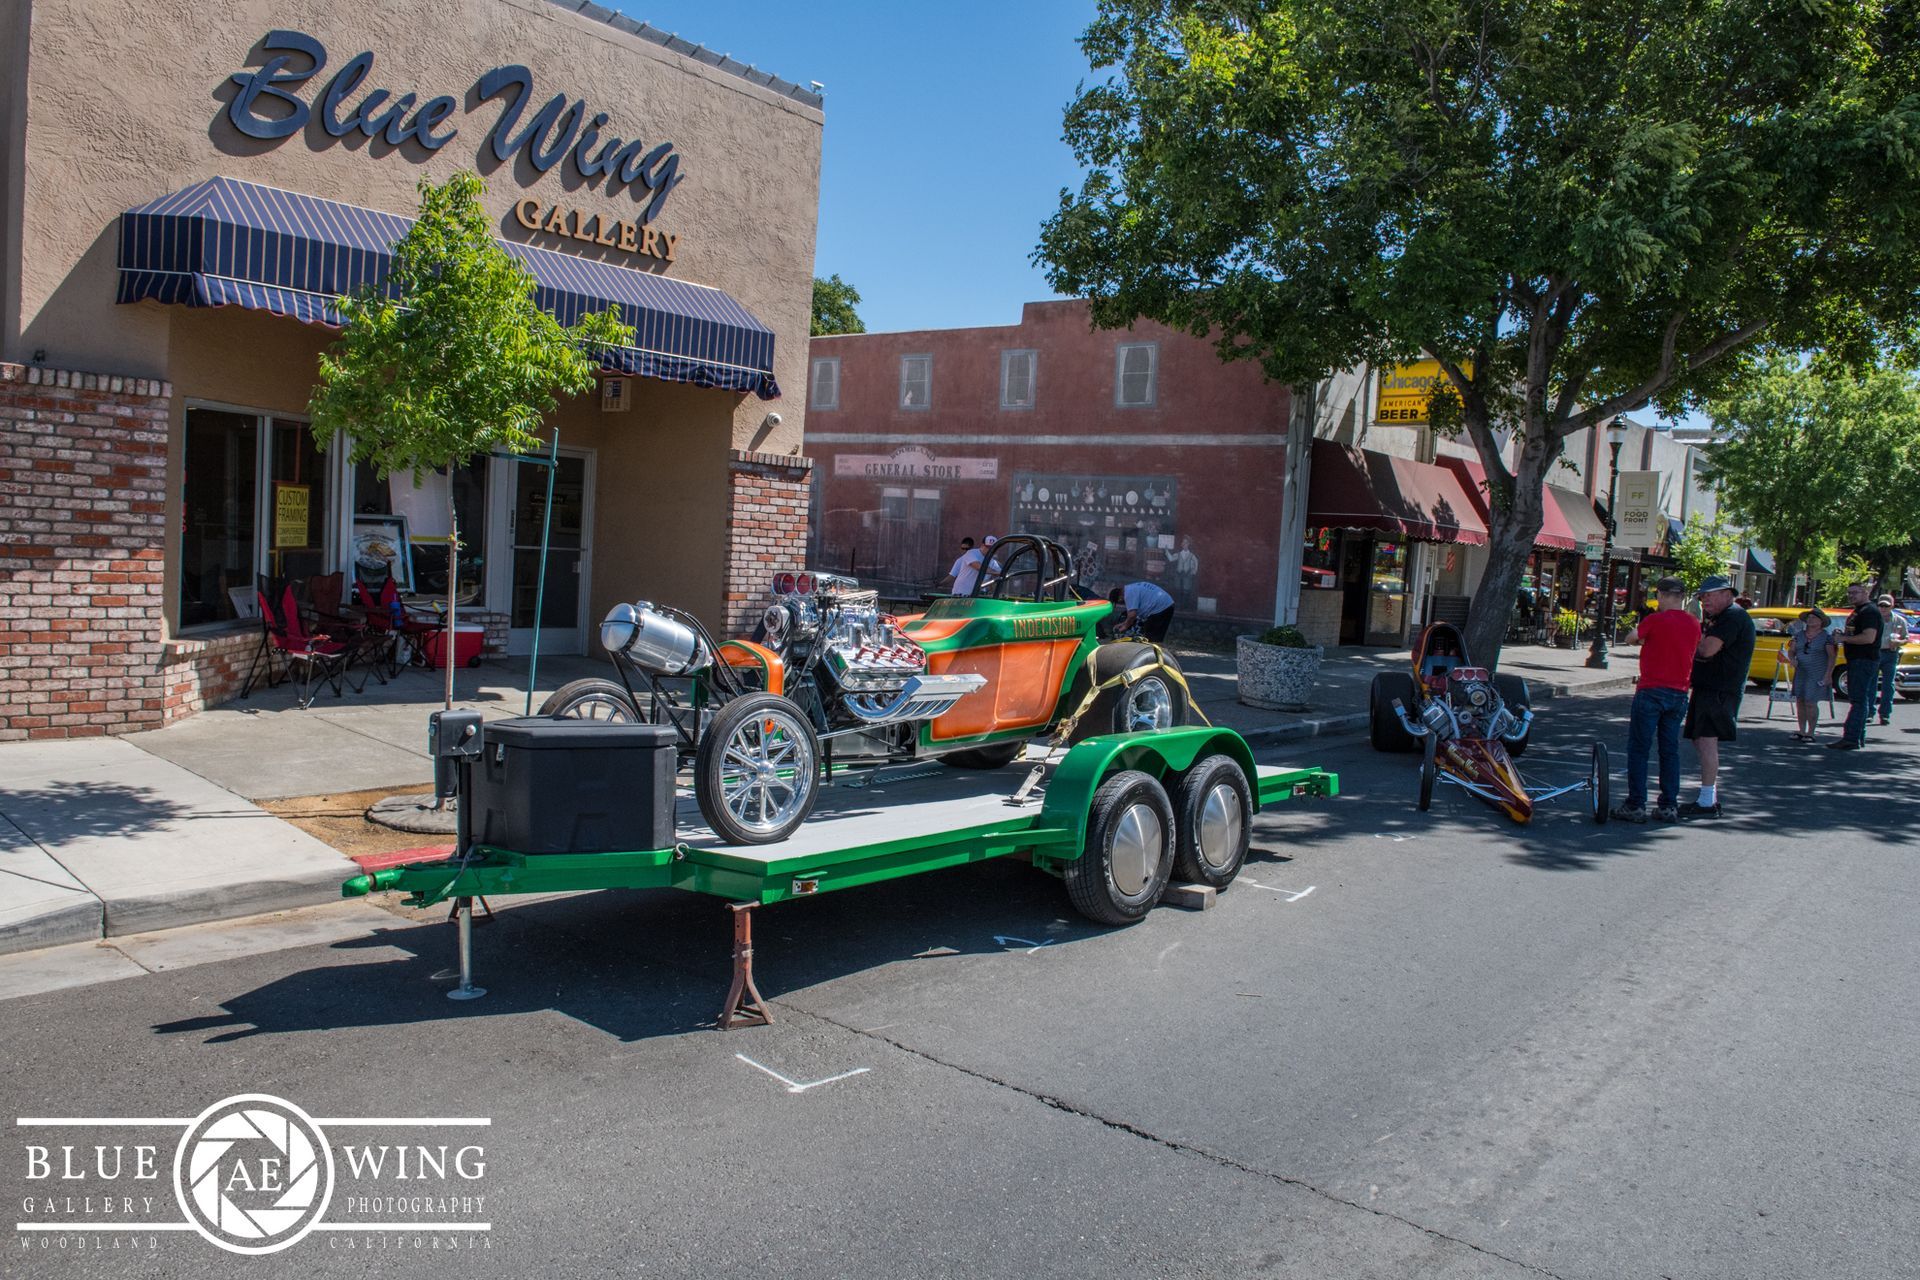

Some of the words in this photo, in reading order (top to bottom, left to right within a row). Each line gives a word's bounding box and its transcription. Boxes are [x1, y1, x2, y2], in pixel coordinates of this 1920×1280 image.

[229, 29, 458, 150] Blue
[479, 64, 685, 222] Wing
[516, 200, 682, 262] GALLERY
[1383, 400, 1422, 408] AMERICAN
[864, 463, 917, 478] GENERAL
[922, 464, 962, 479] STORE
[278, 489, 308, 505] CUSTOM
[1631, 491, 1645, 500] FF
[278, 507, 307, 523] FRAMING
[1013, 615, 1075, 638] INDECISION
